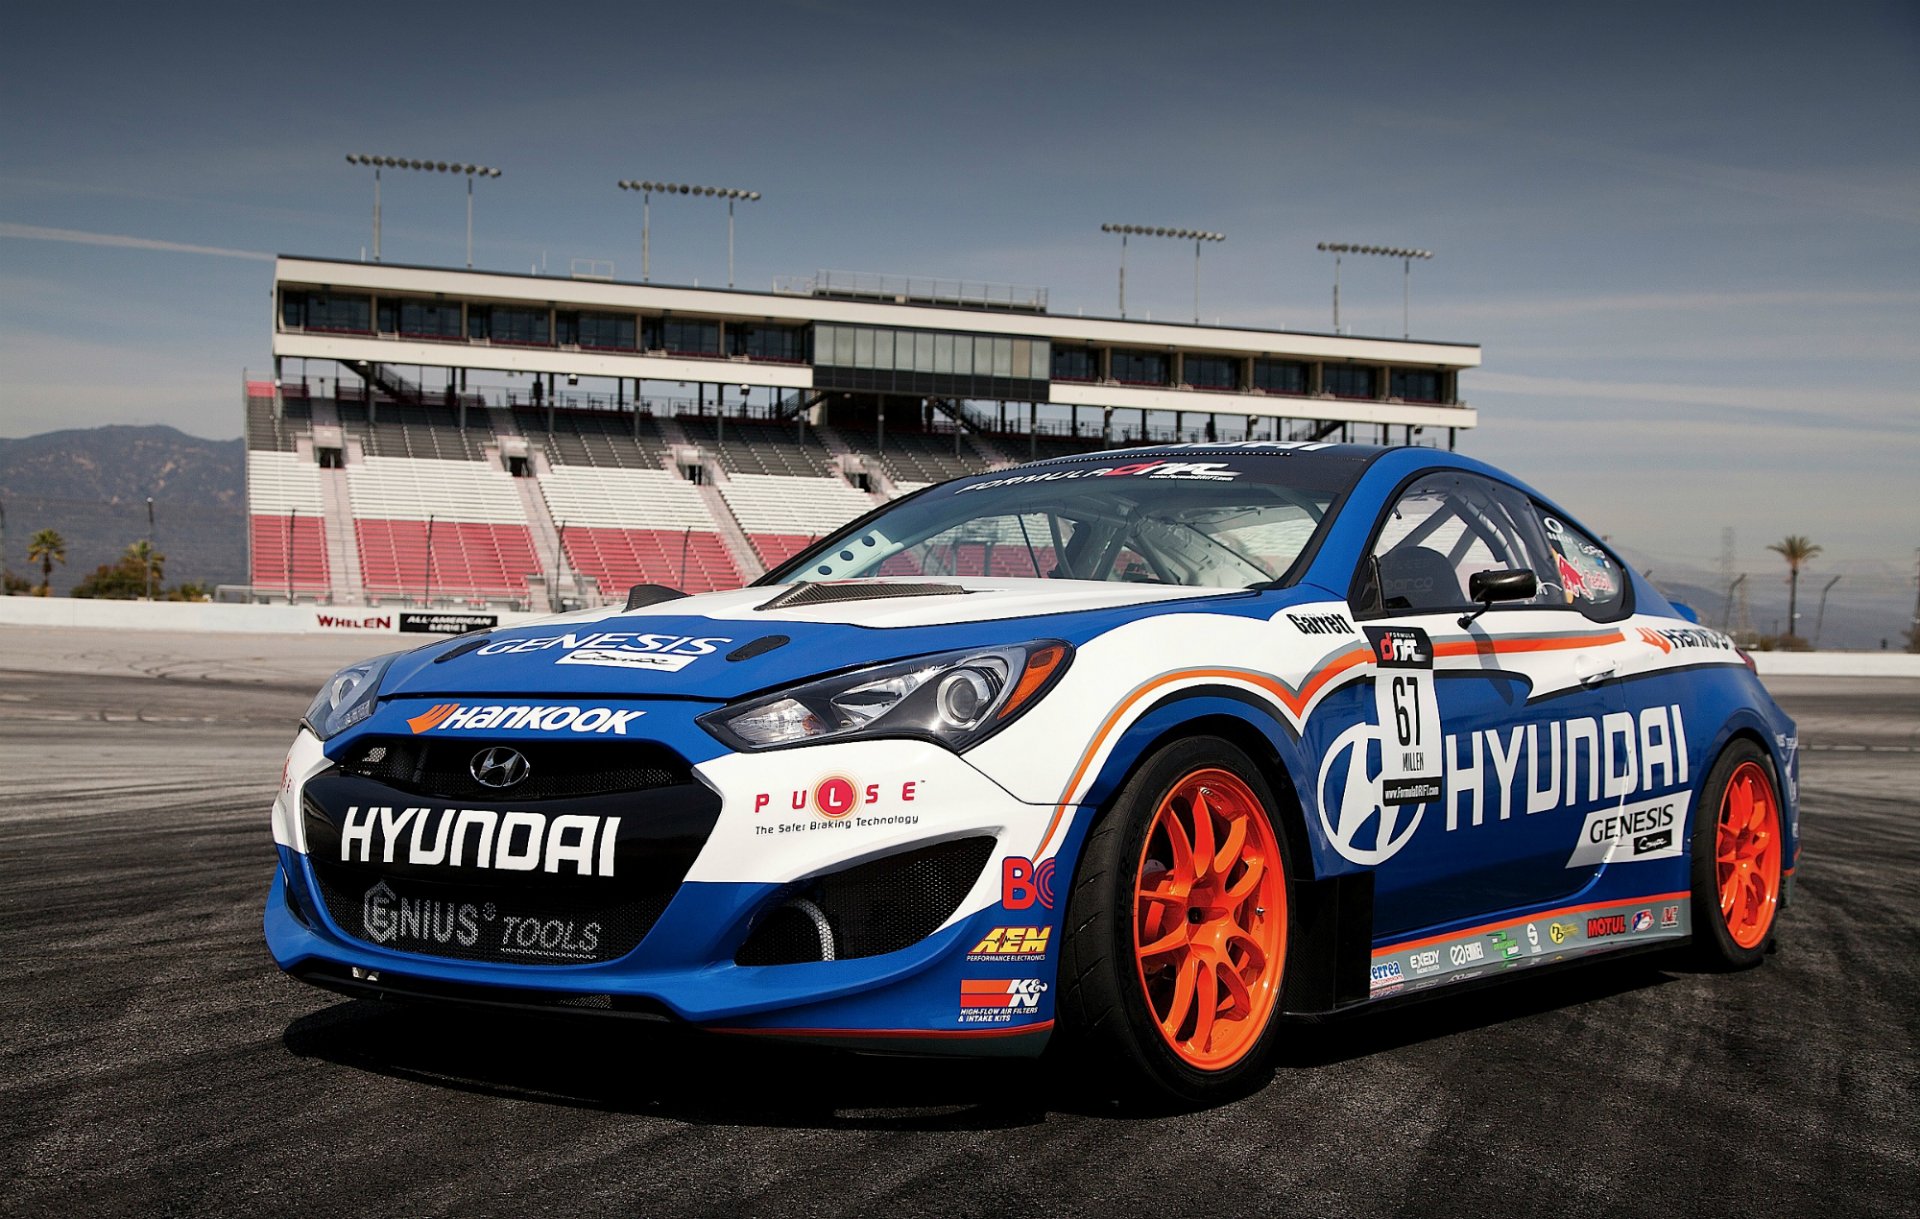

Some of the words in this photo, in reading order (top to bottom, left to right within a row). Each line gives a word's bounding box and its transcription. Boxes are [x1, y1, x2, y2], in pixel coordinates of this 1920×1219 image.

[1286, 613, 1356, 635] Garrett
[477, 632, 733, 656] GENESIS
[1392, 676, 1421, 747] 67
[1402, 752, 1424, 773] MILLEN
[1445, 704, 1689, 832] HYUNDAI
[754, 780, 917, 814] PULSE
[755, 825, 774, 835] The
[778, 823, 806, 834] Safer
[810, 819, 852, 831] Braking
[856, 814, 919, 827] Technology
[1589, 804, 1674, 844] GENESIS
[340, 806, 622, 877] HYUNDAI
[501, 915, 602, 952] TOOLS
[1587, 915, 1627, 938] MOTUL
[968, 926, 1053, 955] AEM
[966, 954, 1011, 962] PERFORMANCE
[1409, 949, 1440, 969] EXEDY
[1371, 960, 1401, 980] errea
[958, 1014, 964, 1022] &
[965, 1014, 993, 1022] INTAKE
[994, 1013, 1011, 1022] KITS
[960, 1008, 999, 1016] HIGH-FLOW
[1000, 1007, 1013, 1015] AIR
[1012, 1006, 1038, 1015] FILTERS
